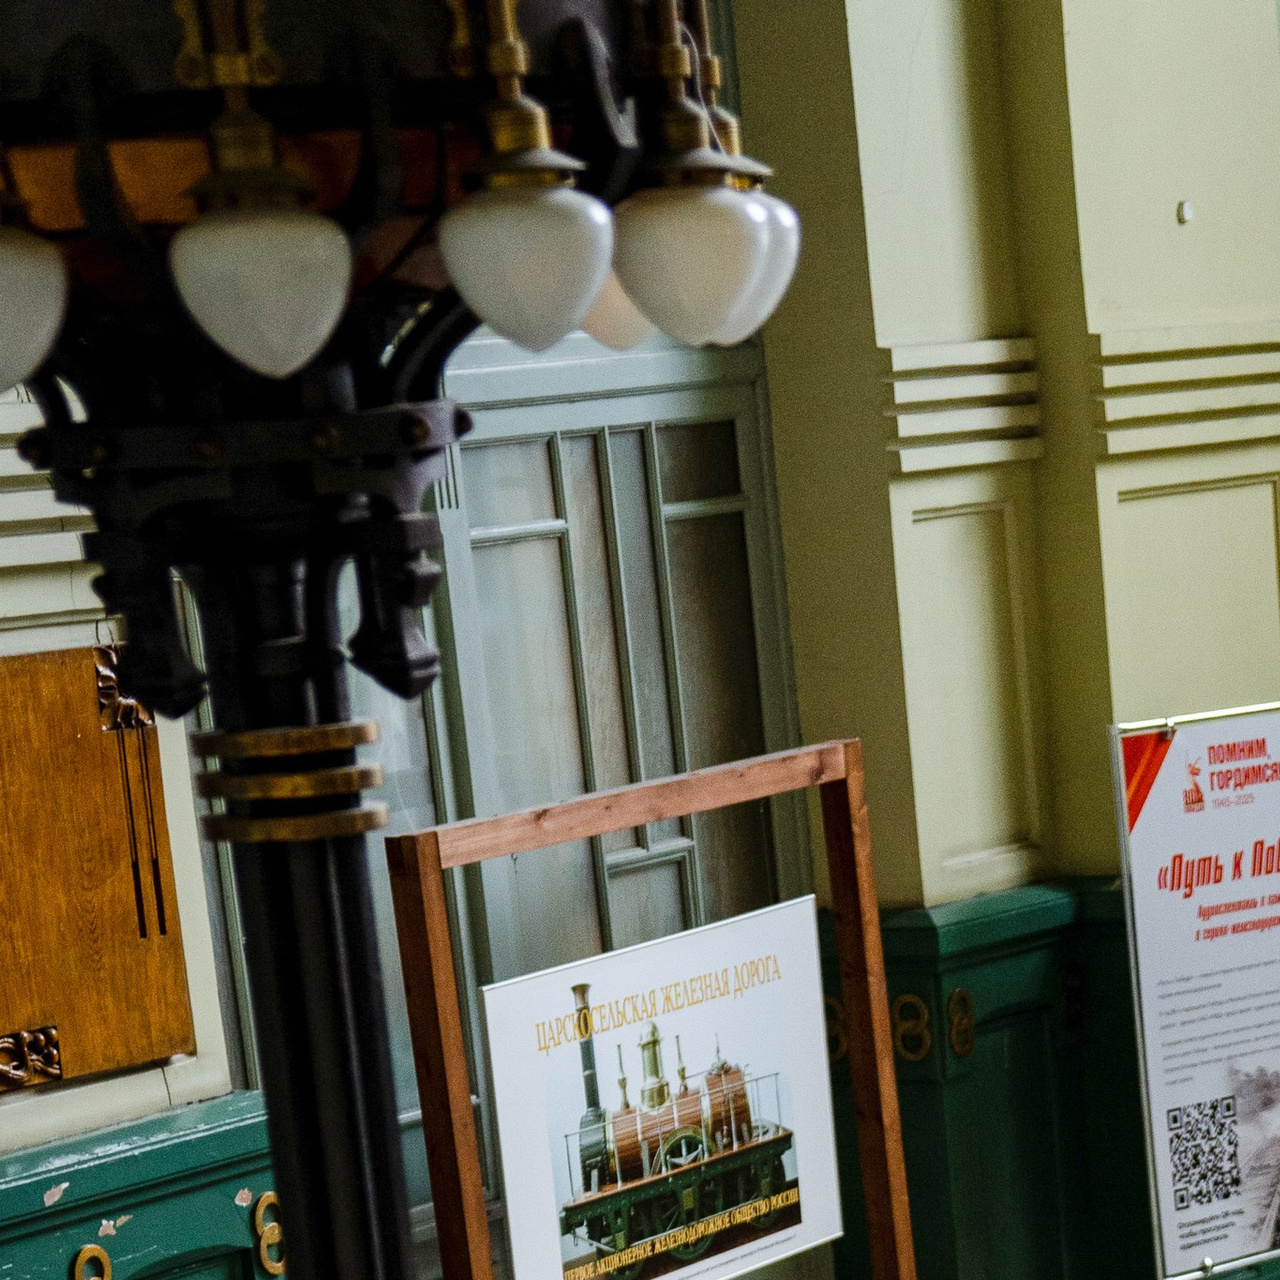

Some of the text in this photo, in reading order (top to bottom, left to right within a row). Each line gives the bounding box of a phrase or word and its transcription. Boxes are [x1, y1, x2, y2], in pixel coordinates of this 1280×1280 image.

[1208, 738, 1271, 765] ПОМНИМ,
[1157, 853, 1223, 898] «Путь
[535, 954, 782, 1055] ЦАРСКОСЕЛЬСКАЯ ЖЕЛЕЗНАЯ ДОРОГА
[596, 1246, 653, 1276] АКЦИОНЕРНОЕ
